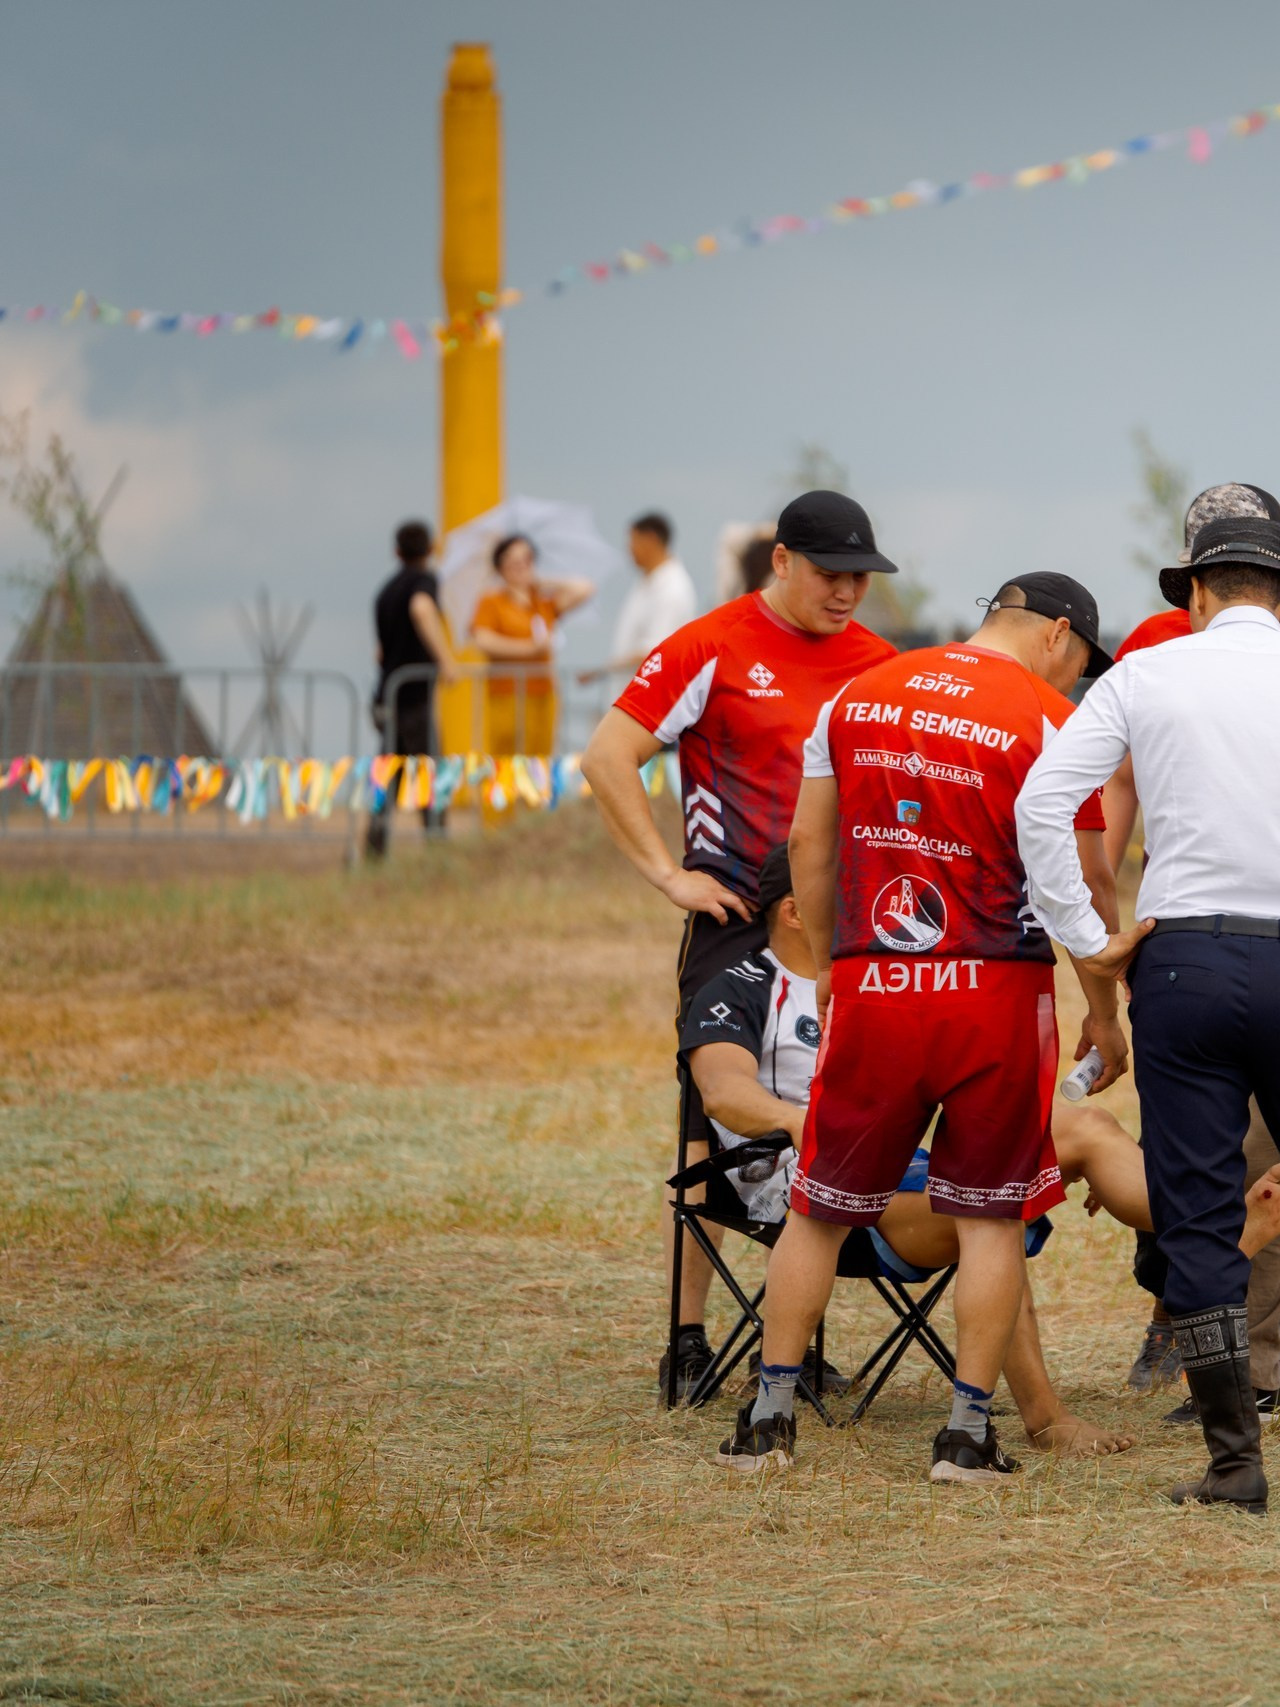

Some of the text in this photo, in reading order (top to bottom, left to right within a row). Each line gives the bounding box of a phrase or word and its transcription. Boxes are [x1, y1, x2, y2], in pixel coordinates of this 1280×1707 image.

[905, 675, 974, 698] ДЭГИТ
[938, 672, 954, 682] СК
[845, 702, 1018, 752] TEAM SEMENOV
[854, 752, 984, 787] АЛМАЗЫ АНАБАРА
[852, 825, 973, 857] САХАНОРДСНАБ
[858, 959, 985, 996] ДЭГИТ
